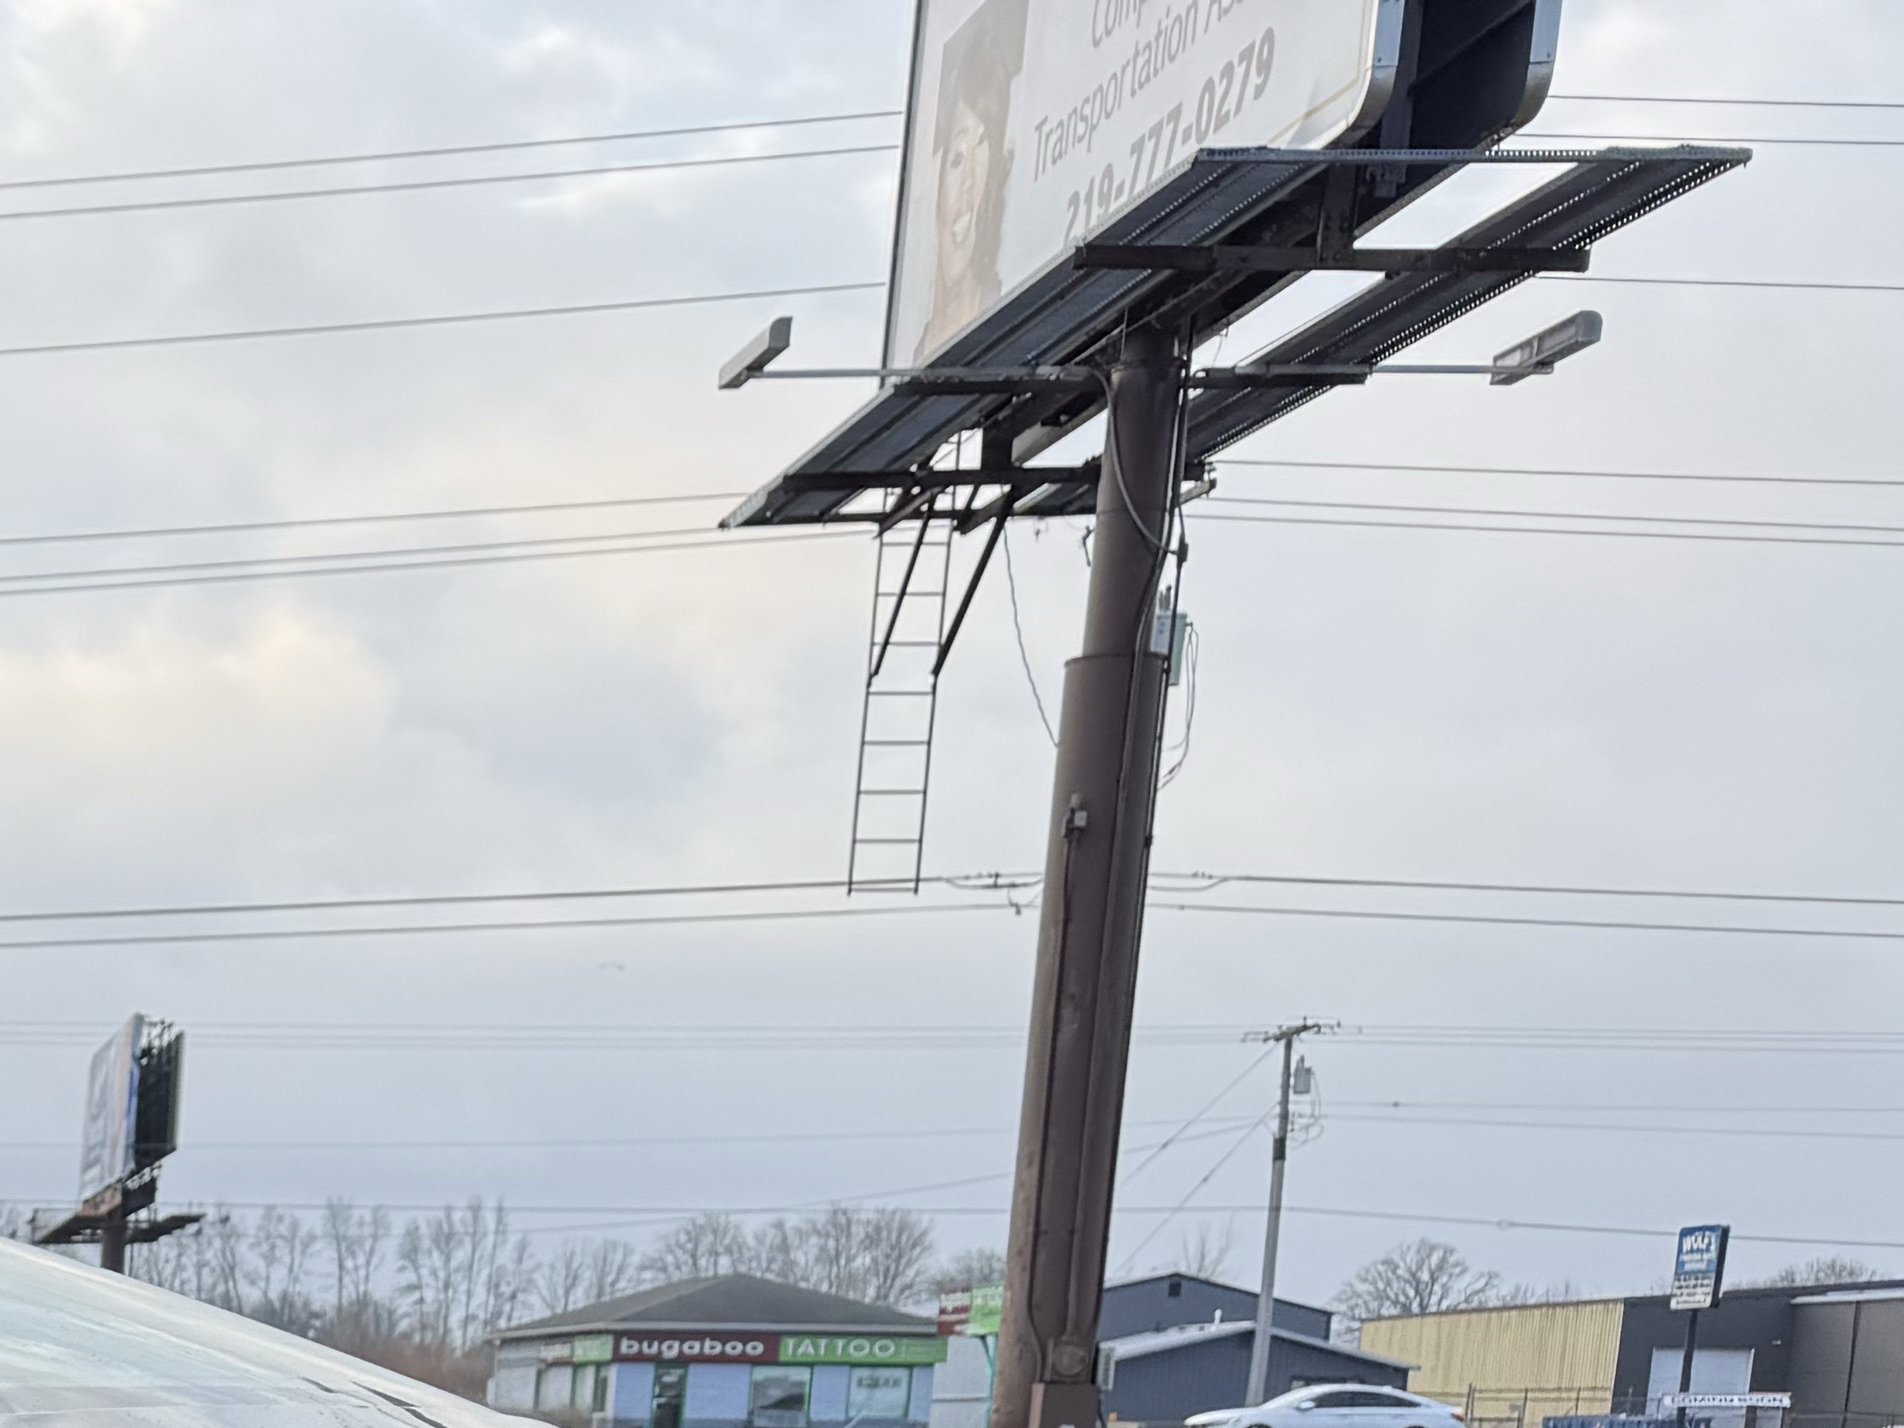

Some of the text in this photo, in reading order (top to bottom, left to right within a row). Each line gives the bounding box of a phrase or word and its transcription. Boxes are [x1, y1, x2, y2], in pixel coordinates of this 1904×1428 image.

[1034, 1, 1198, 182] Transportation
[1062, 26, 1275, 245] 219-777-0279
[620, 1337, 764, 1360] bugaboo
[783, 1338, 895, 1358] TATTOO
